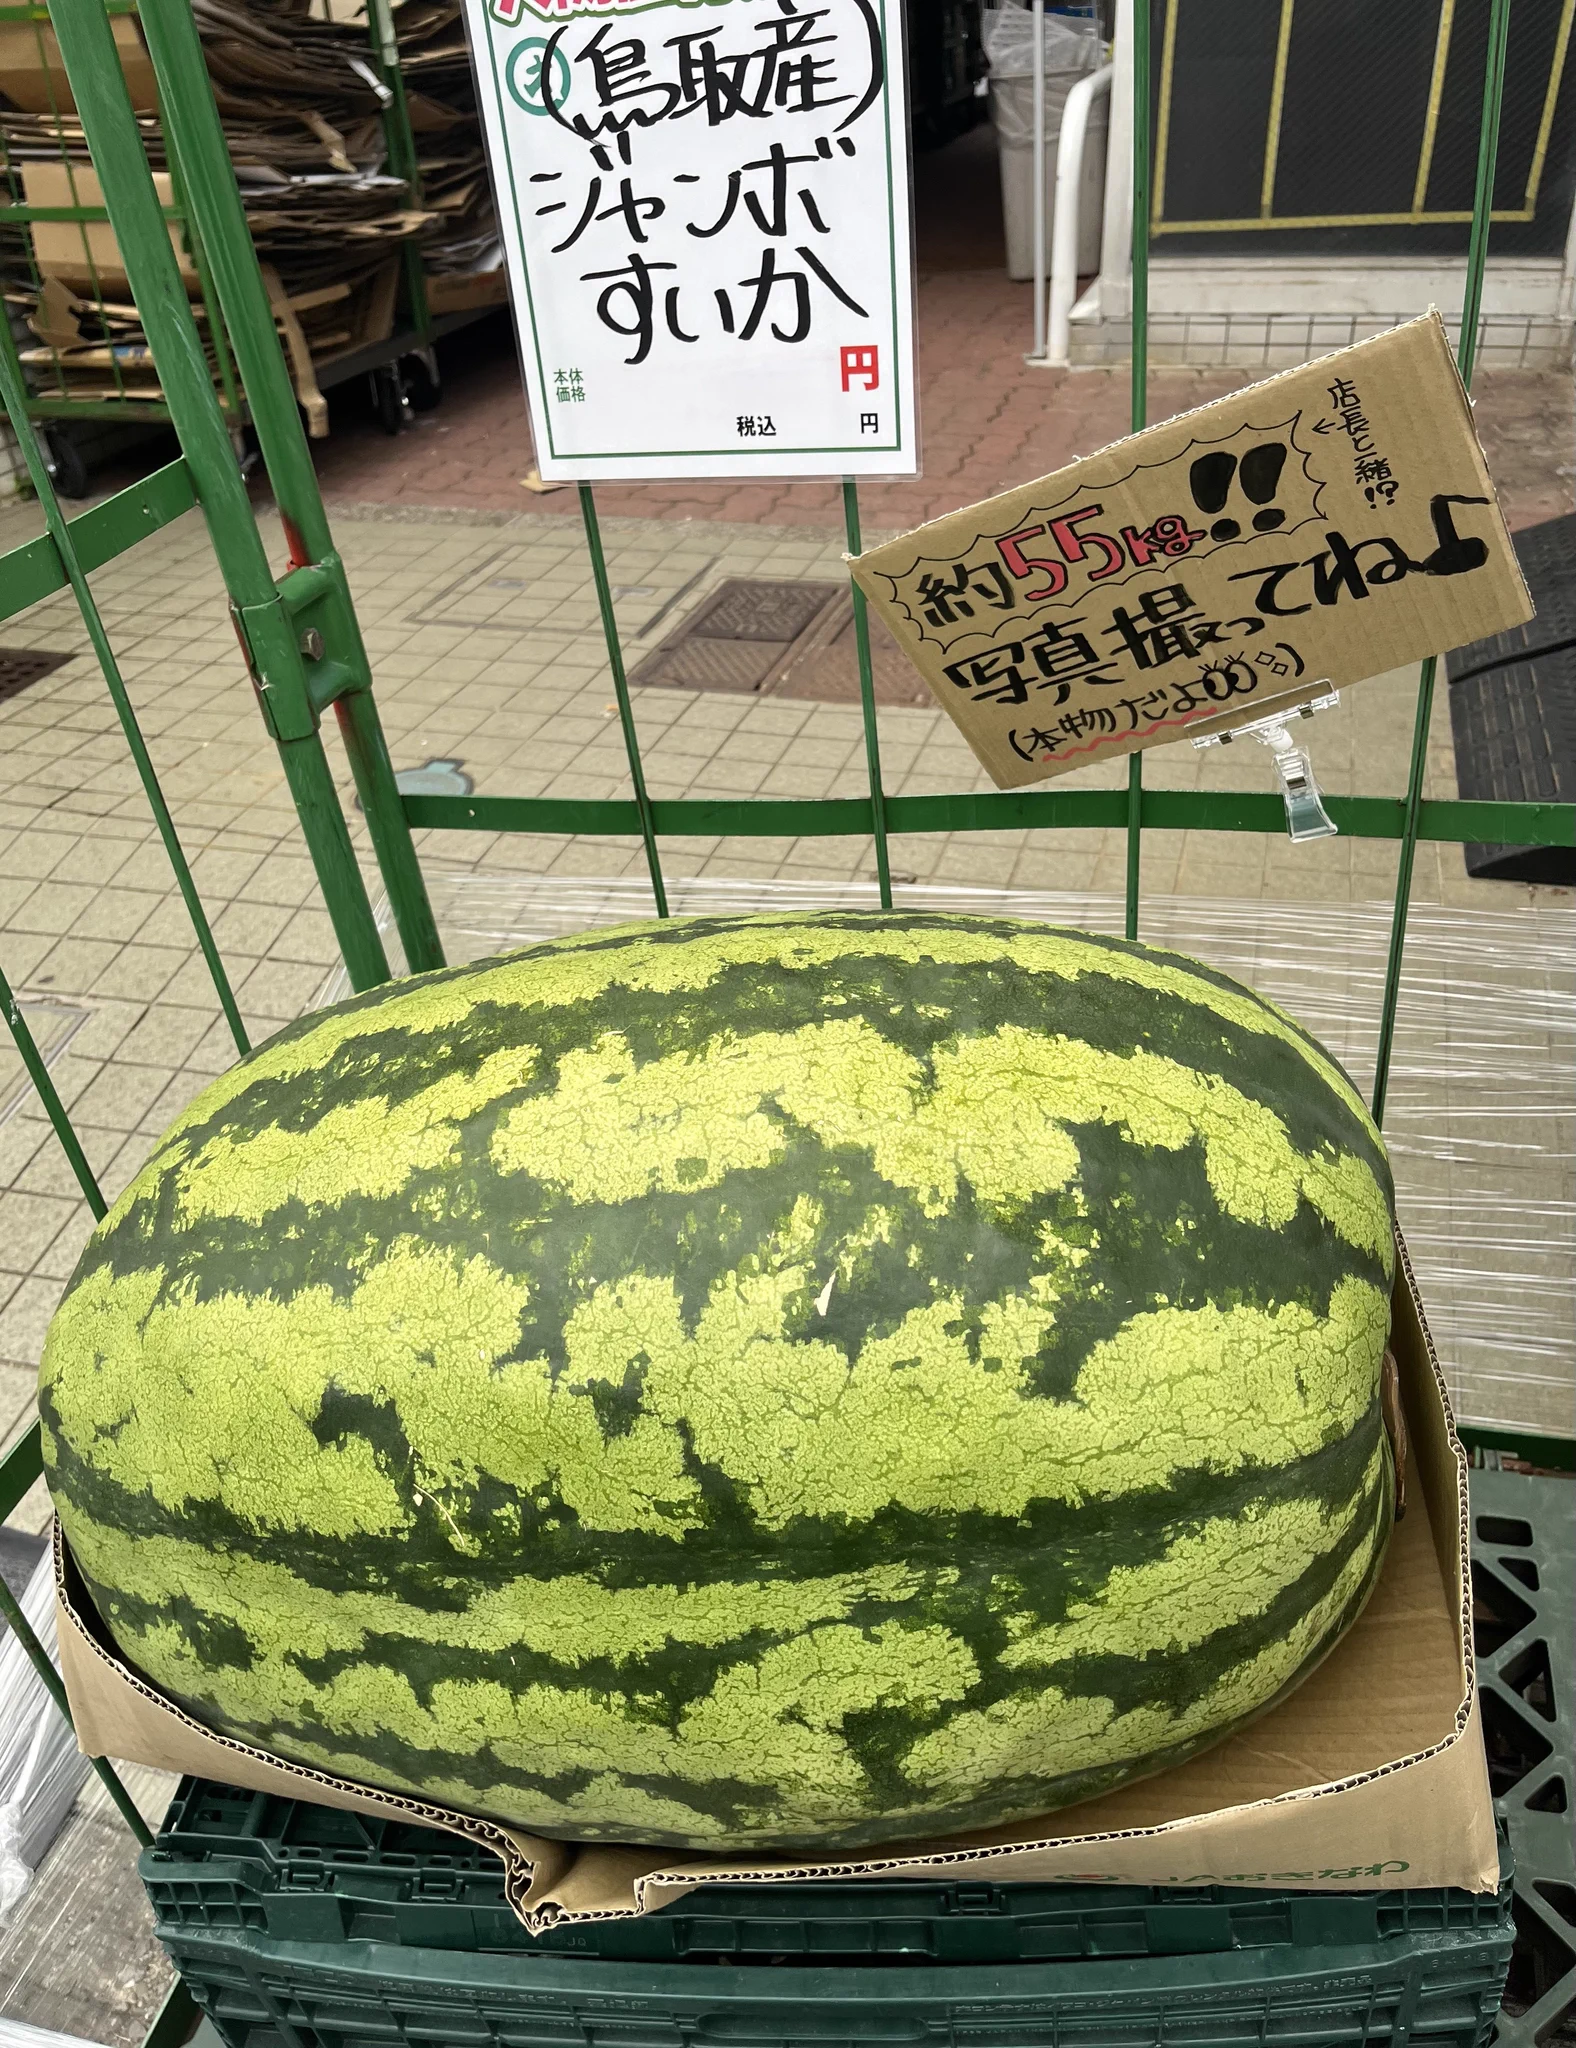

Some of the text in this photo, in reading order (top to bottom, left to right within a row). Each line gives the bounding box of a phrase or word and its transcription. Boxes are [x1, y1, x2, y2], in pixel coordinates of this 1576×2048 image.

[530, 131, 856, 253] ジャンボ
[580, 247, 869, 365] すいか
[553, 369, 584, 386] 本体
[841, 345, 880, 392] 円
[556, 386, 586, 402] 価格
[737, 415, 776, 437] 税込
[860, 413, 879, 434] 円
